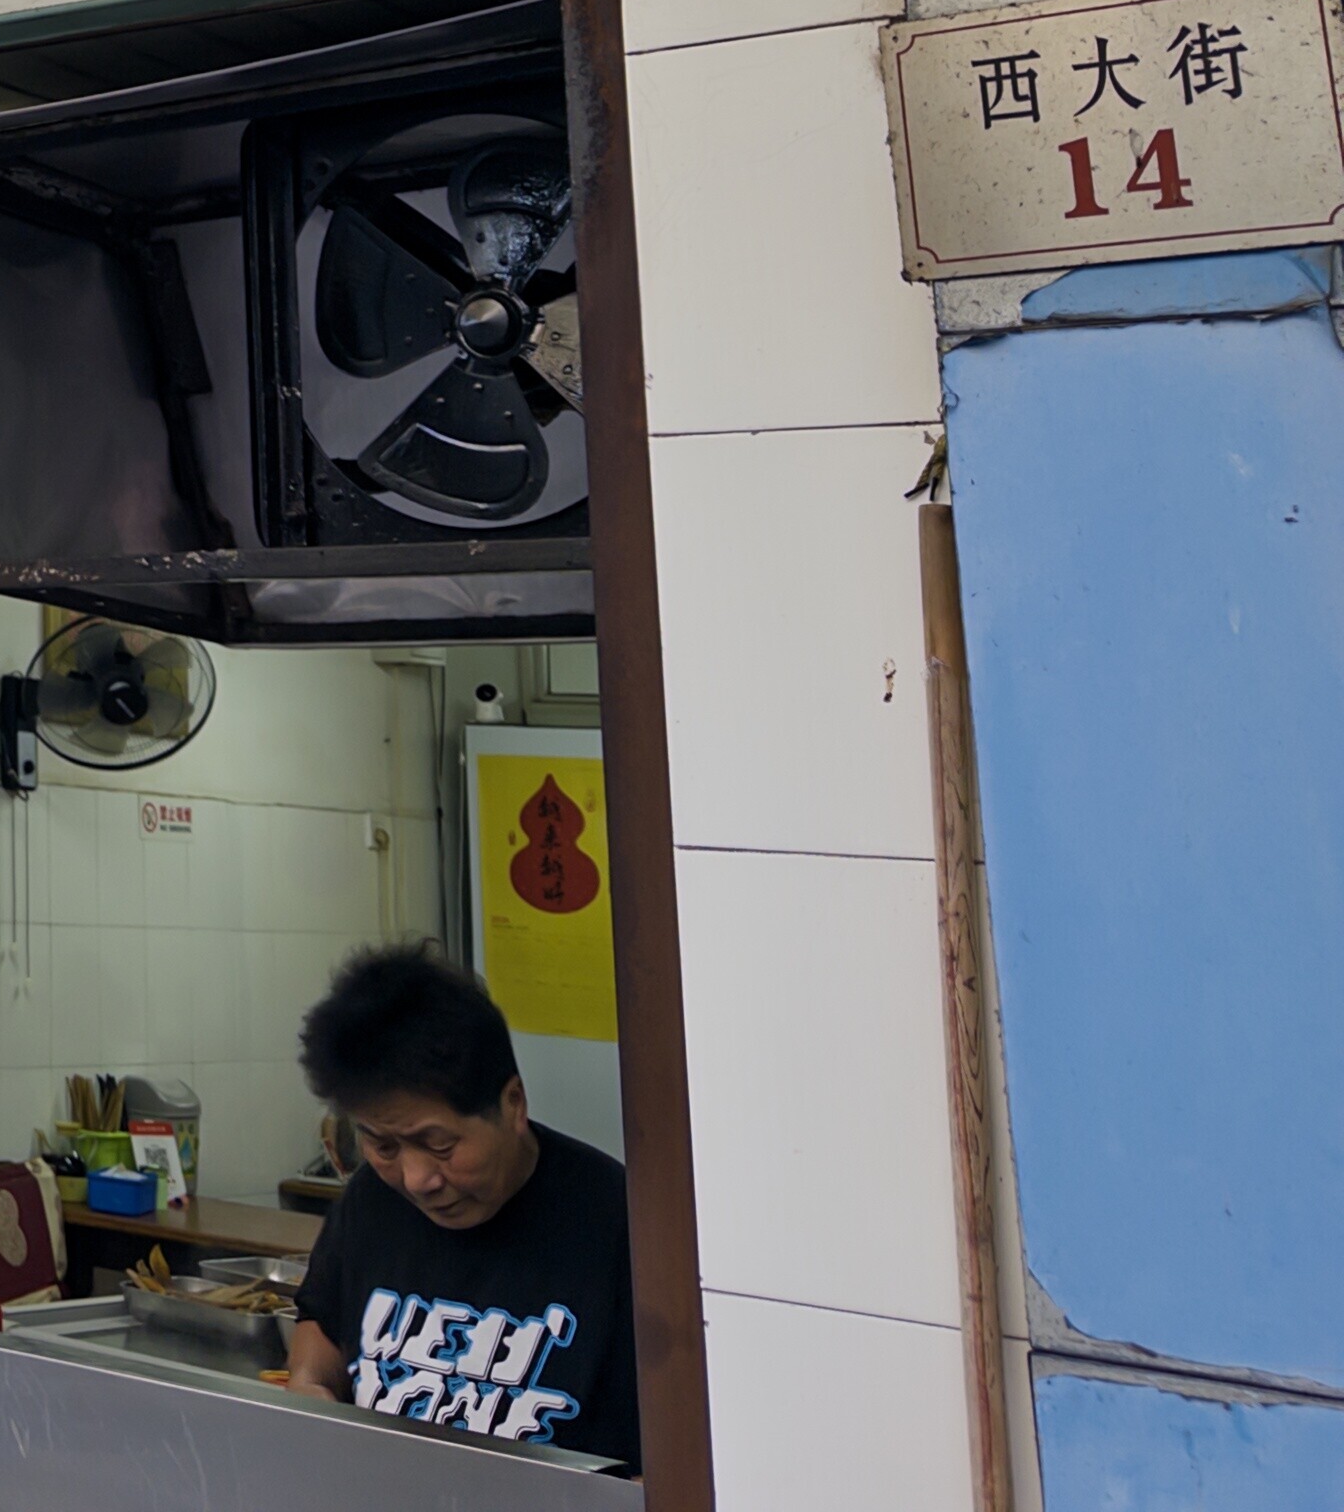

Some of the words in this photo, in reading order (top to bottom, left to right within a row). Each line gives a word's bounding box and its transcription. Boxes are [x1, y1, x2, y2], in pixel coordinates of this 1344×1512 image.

[971, 22, 1249, 130] 西大街
[1058, 128, 1194, 220] 14
